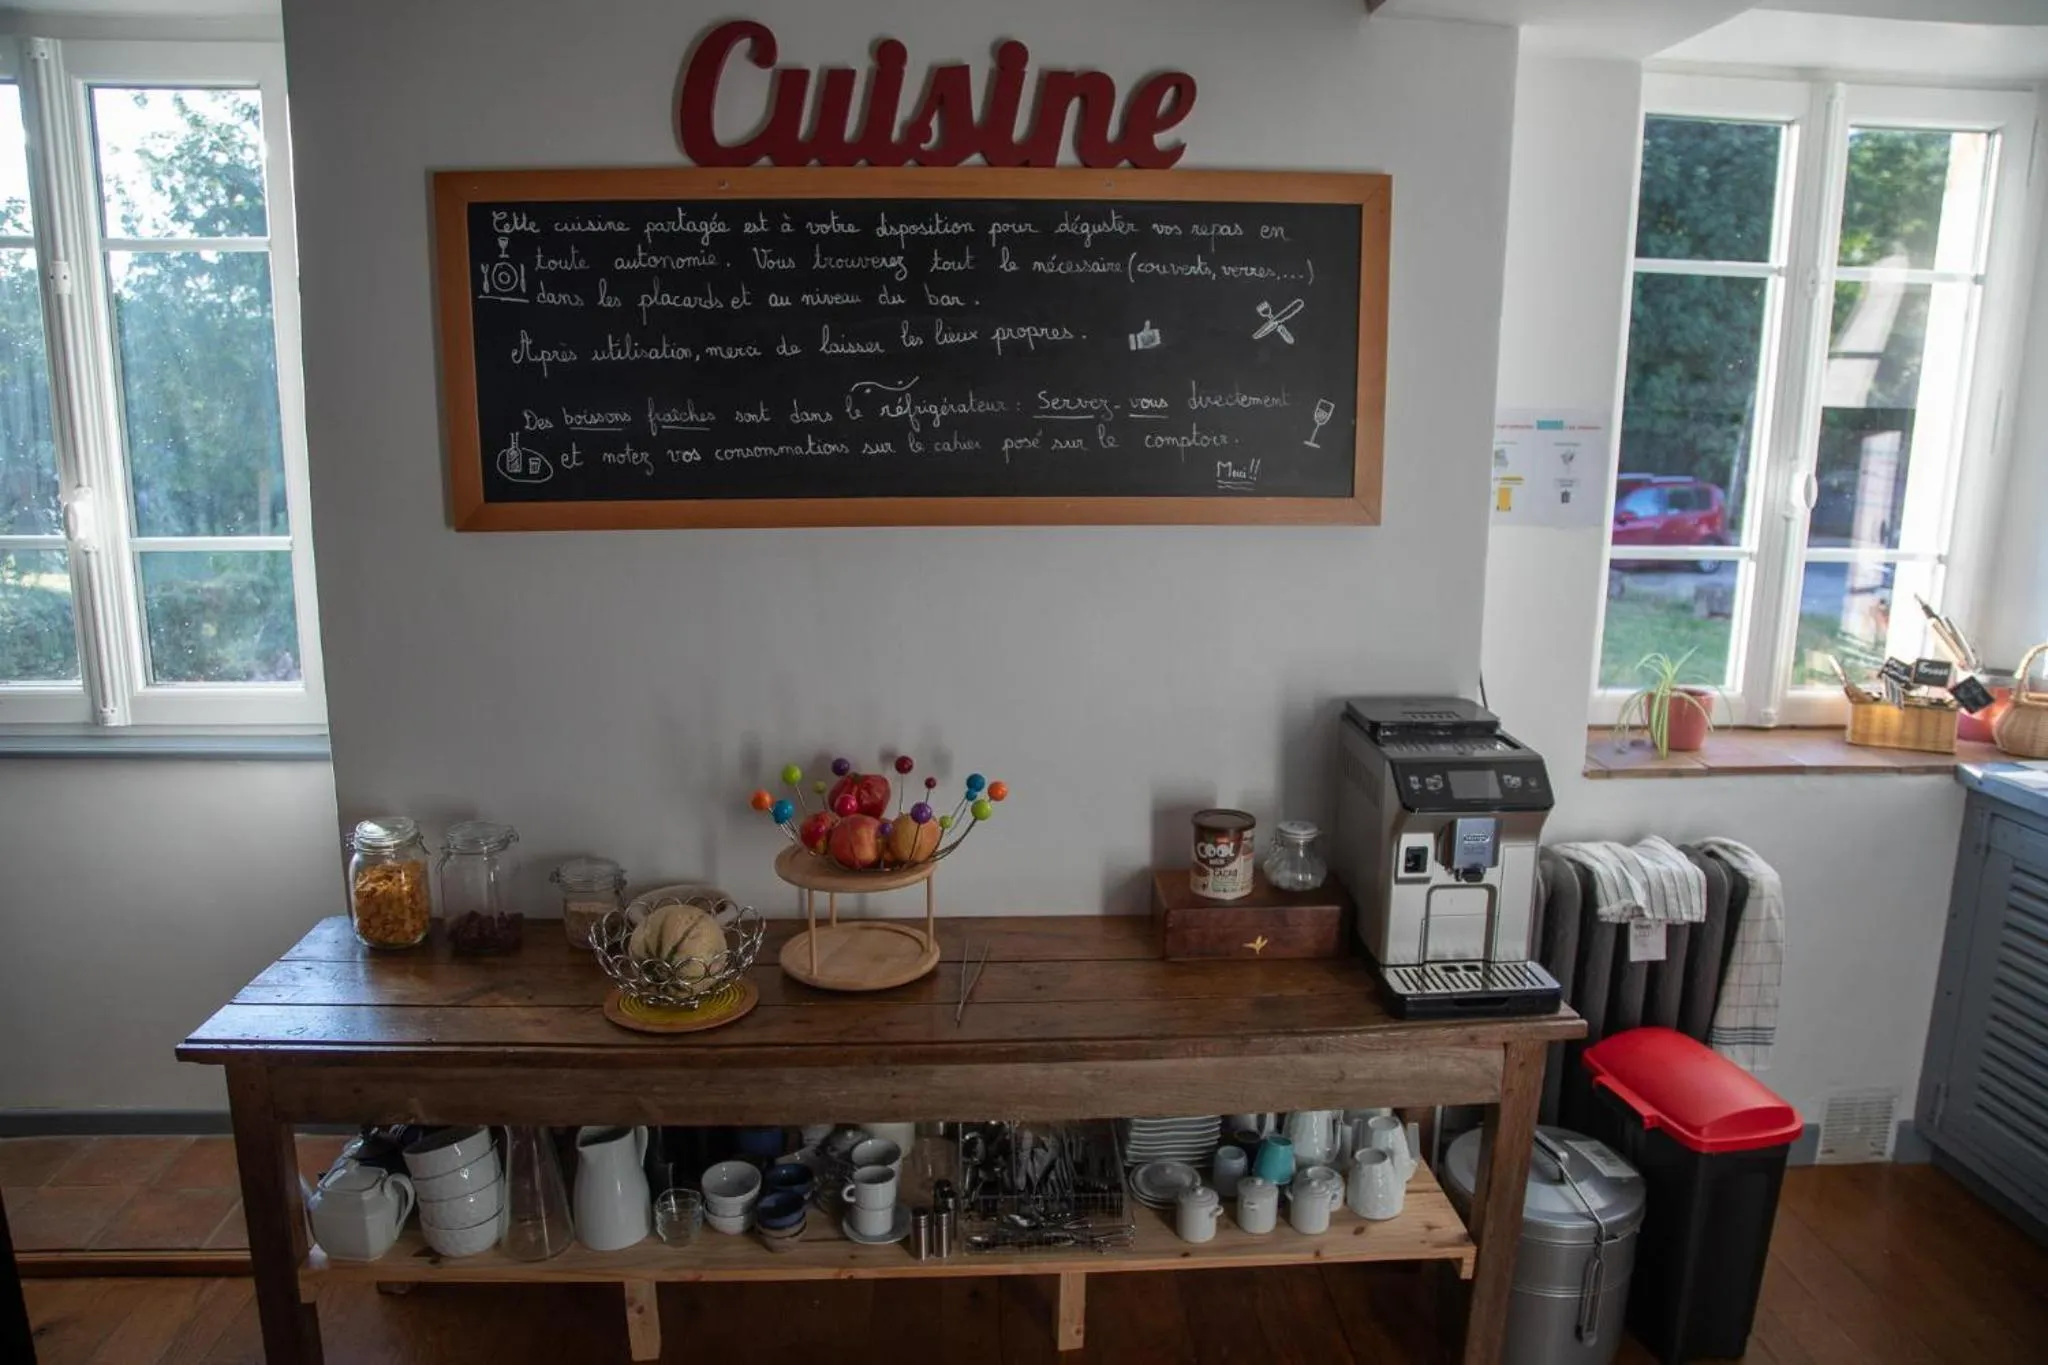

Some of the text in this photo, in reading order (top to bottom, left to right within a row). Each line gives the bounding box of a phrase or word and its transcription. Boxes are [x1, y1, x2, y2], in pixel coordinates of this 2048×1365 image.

[680, 20, 1197, 168] Cuisine
[492, 208, 1287, 252] Cette cuisine partagée est à votre disposition pour déguster vos repas en
[535, 245, 589, 271] toute
[614, 249, 731, 269] autonomie.
[753, 246, 796, 269] Vous
[813, 245, 906, 281] trouverez
[930, 247, 976, 271] tout
[999, 247, 1019, 271] le
[1032, 254, 1122, 274] nécessaire
[536, 281, 584, 306] dans
[598, 279, 622, 306] les
[638, 279, 724, 324] placards
[731, 287, 752, 308] et
[768, 294, 791, 306] au
[801, 289, 862, 306] niveau
[878, 285, 905, 306] du
[512, 330, 578, 377] Après
[591, 334, 700, 361] utilisation,
[705, 343, 761, 357] merci
[776, 335, 802, 354] de
[819, 325, 886, 354] laisser
[900, 321, 925, 347] les
[935, 319, 978, 345] lieux
[525, 408, 554, 430] Des
[564, 401, 632, 425] boissons
[648, 397, 716, 435] fraîches
[735, 401, 770, 423] sont
[789, 400, 833, 423] dans
[845, 395, 863, 421] le
[1188, 381, 1290, 411] directement
[560, 443, 583, 469] et
[602, 448, 652, 476] notez
[668, 449, 702, 463] vos
[715, 434, 850, 462] consommations
[862, 443, 897, 456] sur
[909, 431, 926, 453] le
[933, 432, 982, 452] cahier
[1001, 429, 1042, 463] posé
[1051, 436, 1088, 451] sur
[1098, 425, 1119, 449] le
